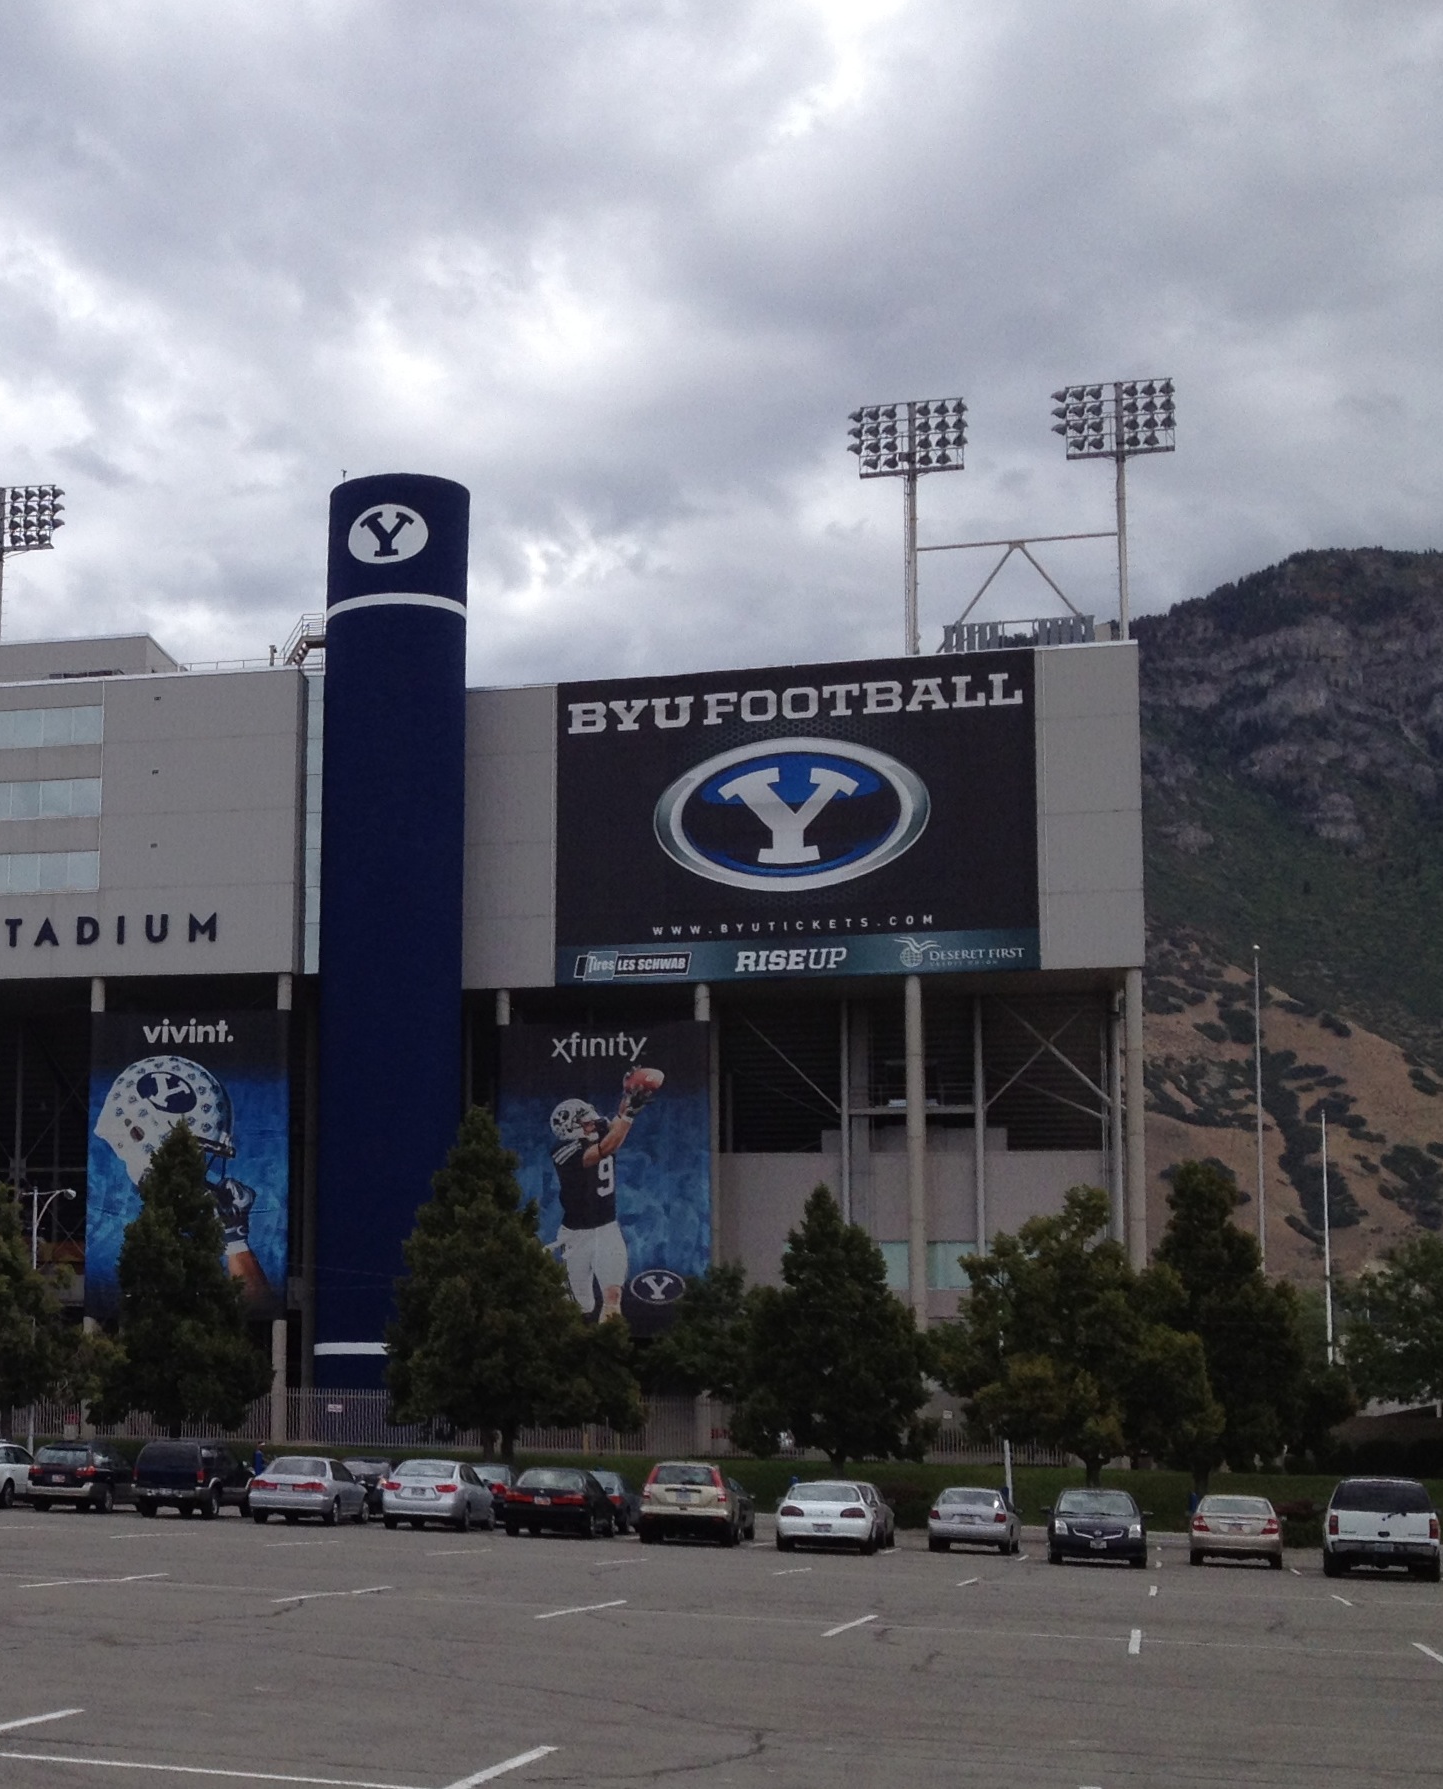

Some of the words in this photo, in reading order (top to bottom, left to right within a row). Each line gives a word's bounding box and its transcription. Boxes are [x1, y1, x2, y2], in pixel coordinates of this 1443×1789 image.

[360, 511, 414, 557] Y
[568, 696, 694, 735] BYU
[703, 673, 1024, 726] FOOTBALL
[718, 767, 859, 864] Y
[652, 914, 934, 936] WWW.BYUTICKETS.COM
[617, 958, 636, 971] LES
[637, 957, 686, 971] SCHWAB
[929, 949, 984, 961] DESERET
[988, 947, 1025, 959] FIRST
[551, 1031, 647, 1063] xfinity
[597, 1154, 615, 1198] 9
